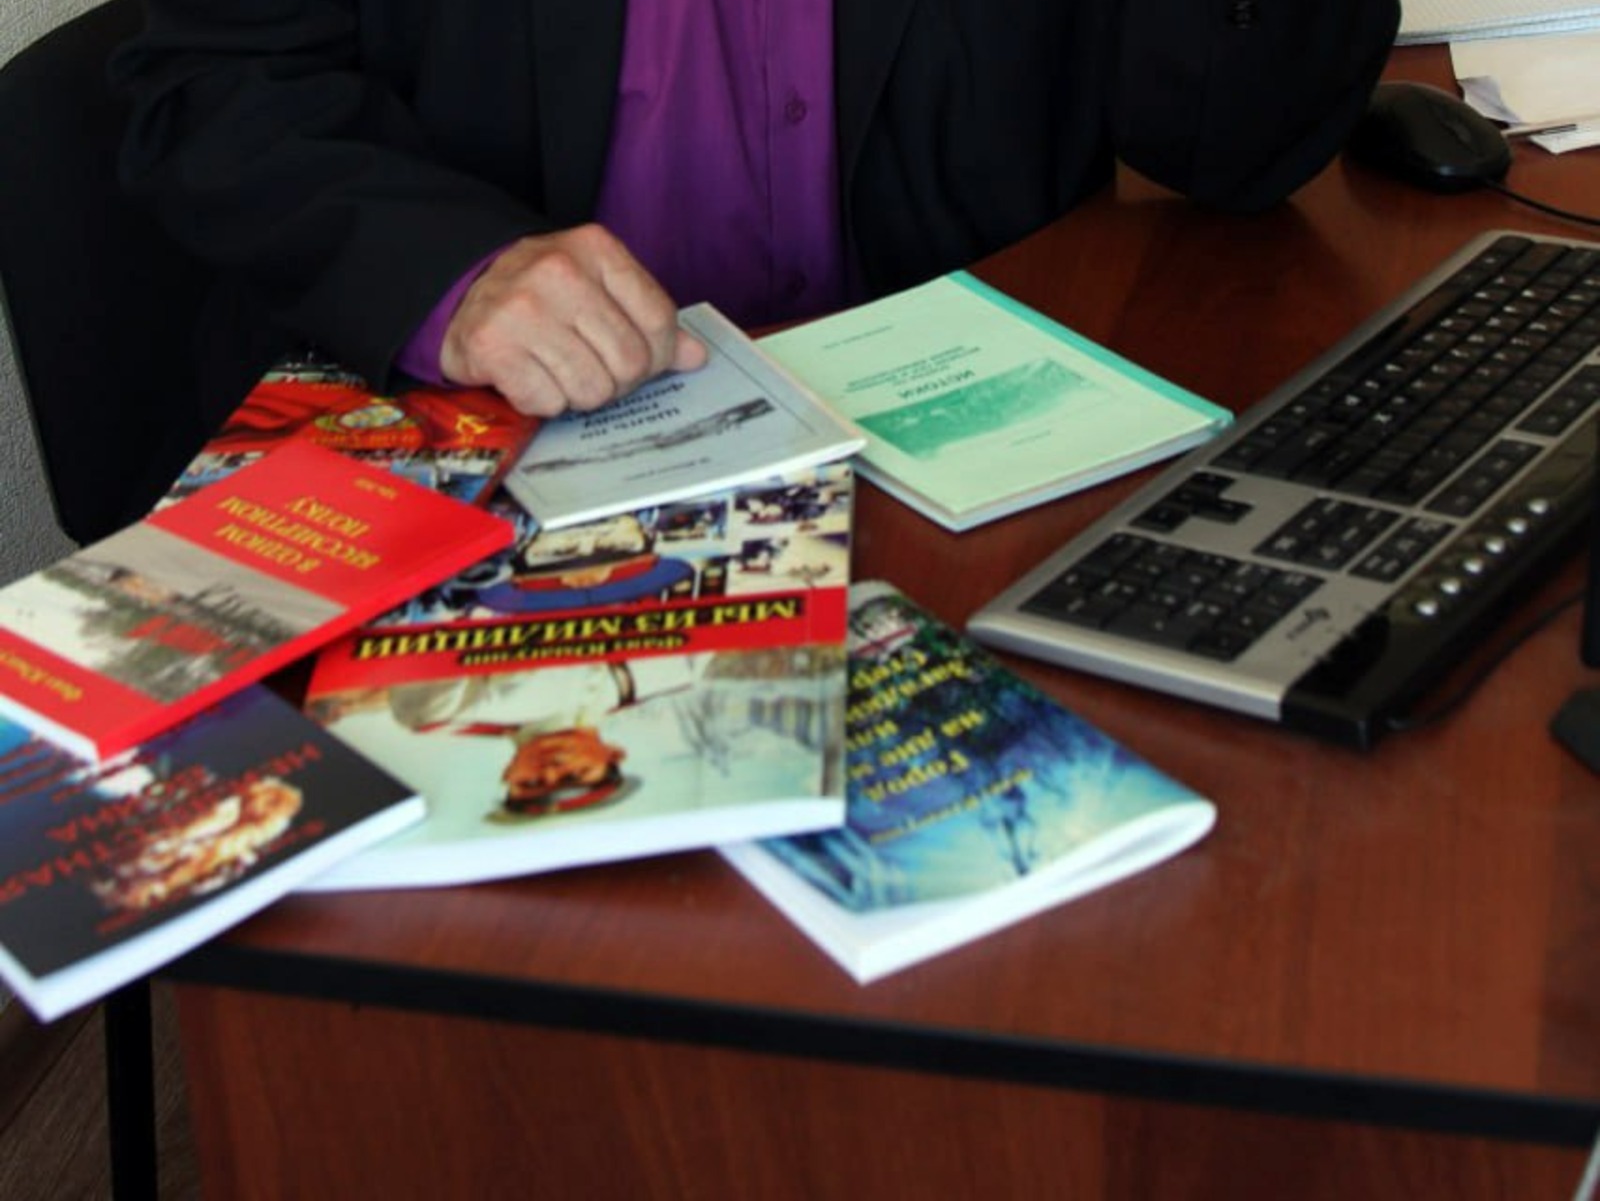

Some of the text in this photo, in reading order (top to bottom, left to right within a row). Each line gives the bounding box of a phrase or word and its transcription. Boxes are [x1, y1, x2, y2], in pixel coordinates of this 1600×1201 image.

[215, 495, 382, 571] БЕССМЕРТНОМ
[283, 496, 371, 540] ПОЛКУ
[355, 598, 798, 662] МЫ ИЗ МИЛИЦИИ
[866, 749, 971, 804] Город
